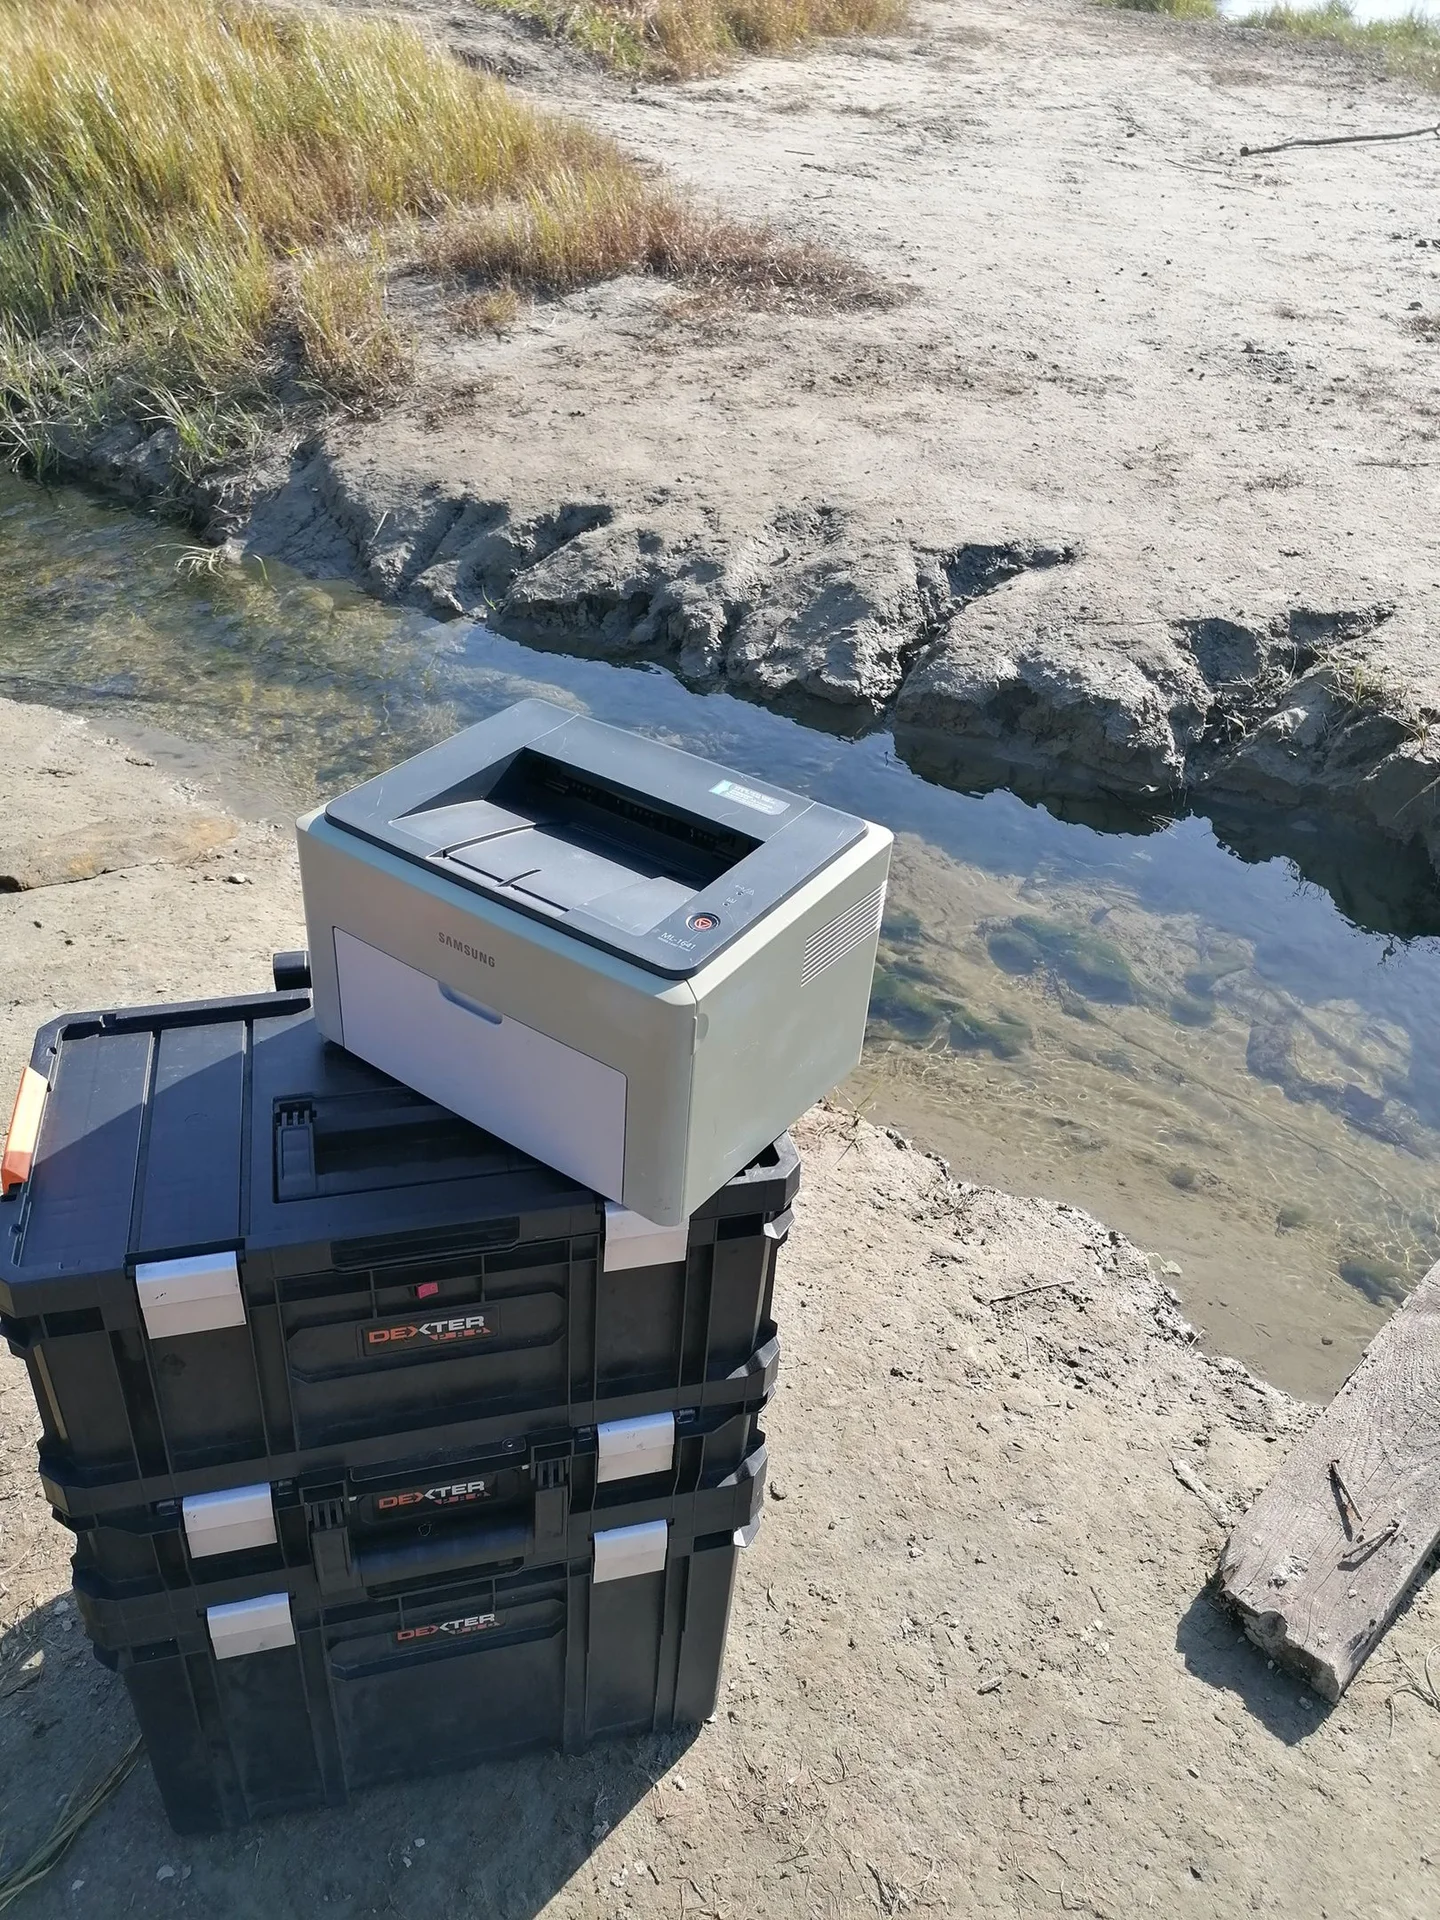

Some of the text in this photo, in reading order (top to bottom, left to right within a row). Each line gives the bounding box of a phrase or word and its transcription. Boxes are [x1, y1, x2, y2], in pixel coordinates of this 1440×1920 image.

[438, 931, 496, 968] SAMSUNG
[661, 932, 697, 950] ML-1641
[369, 1315, 485, 1343] DEXTER
[378, 1480, 485, 1509] DEXTER
[397, 1613, 495, 1641] DEXTER
